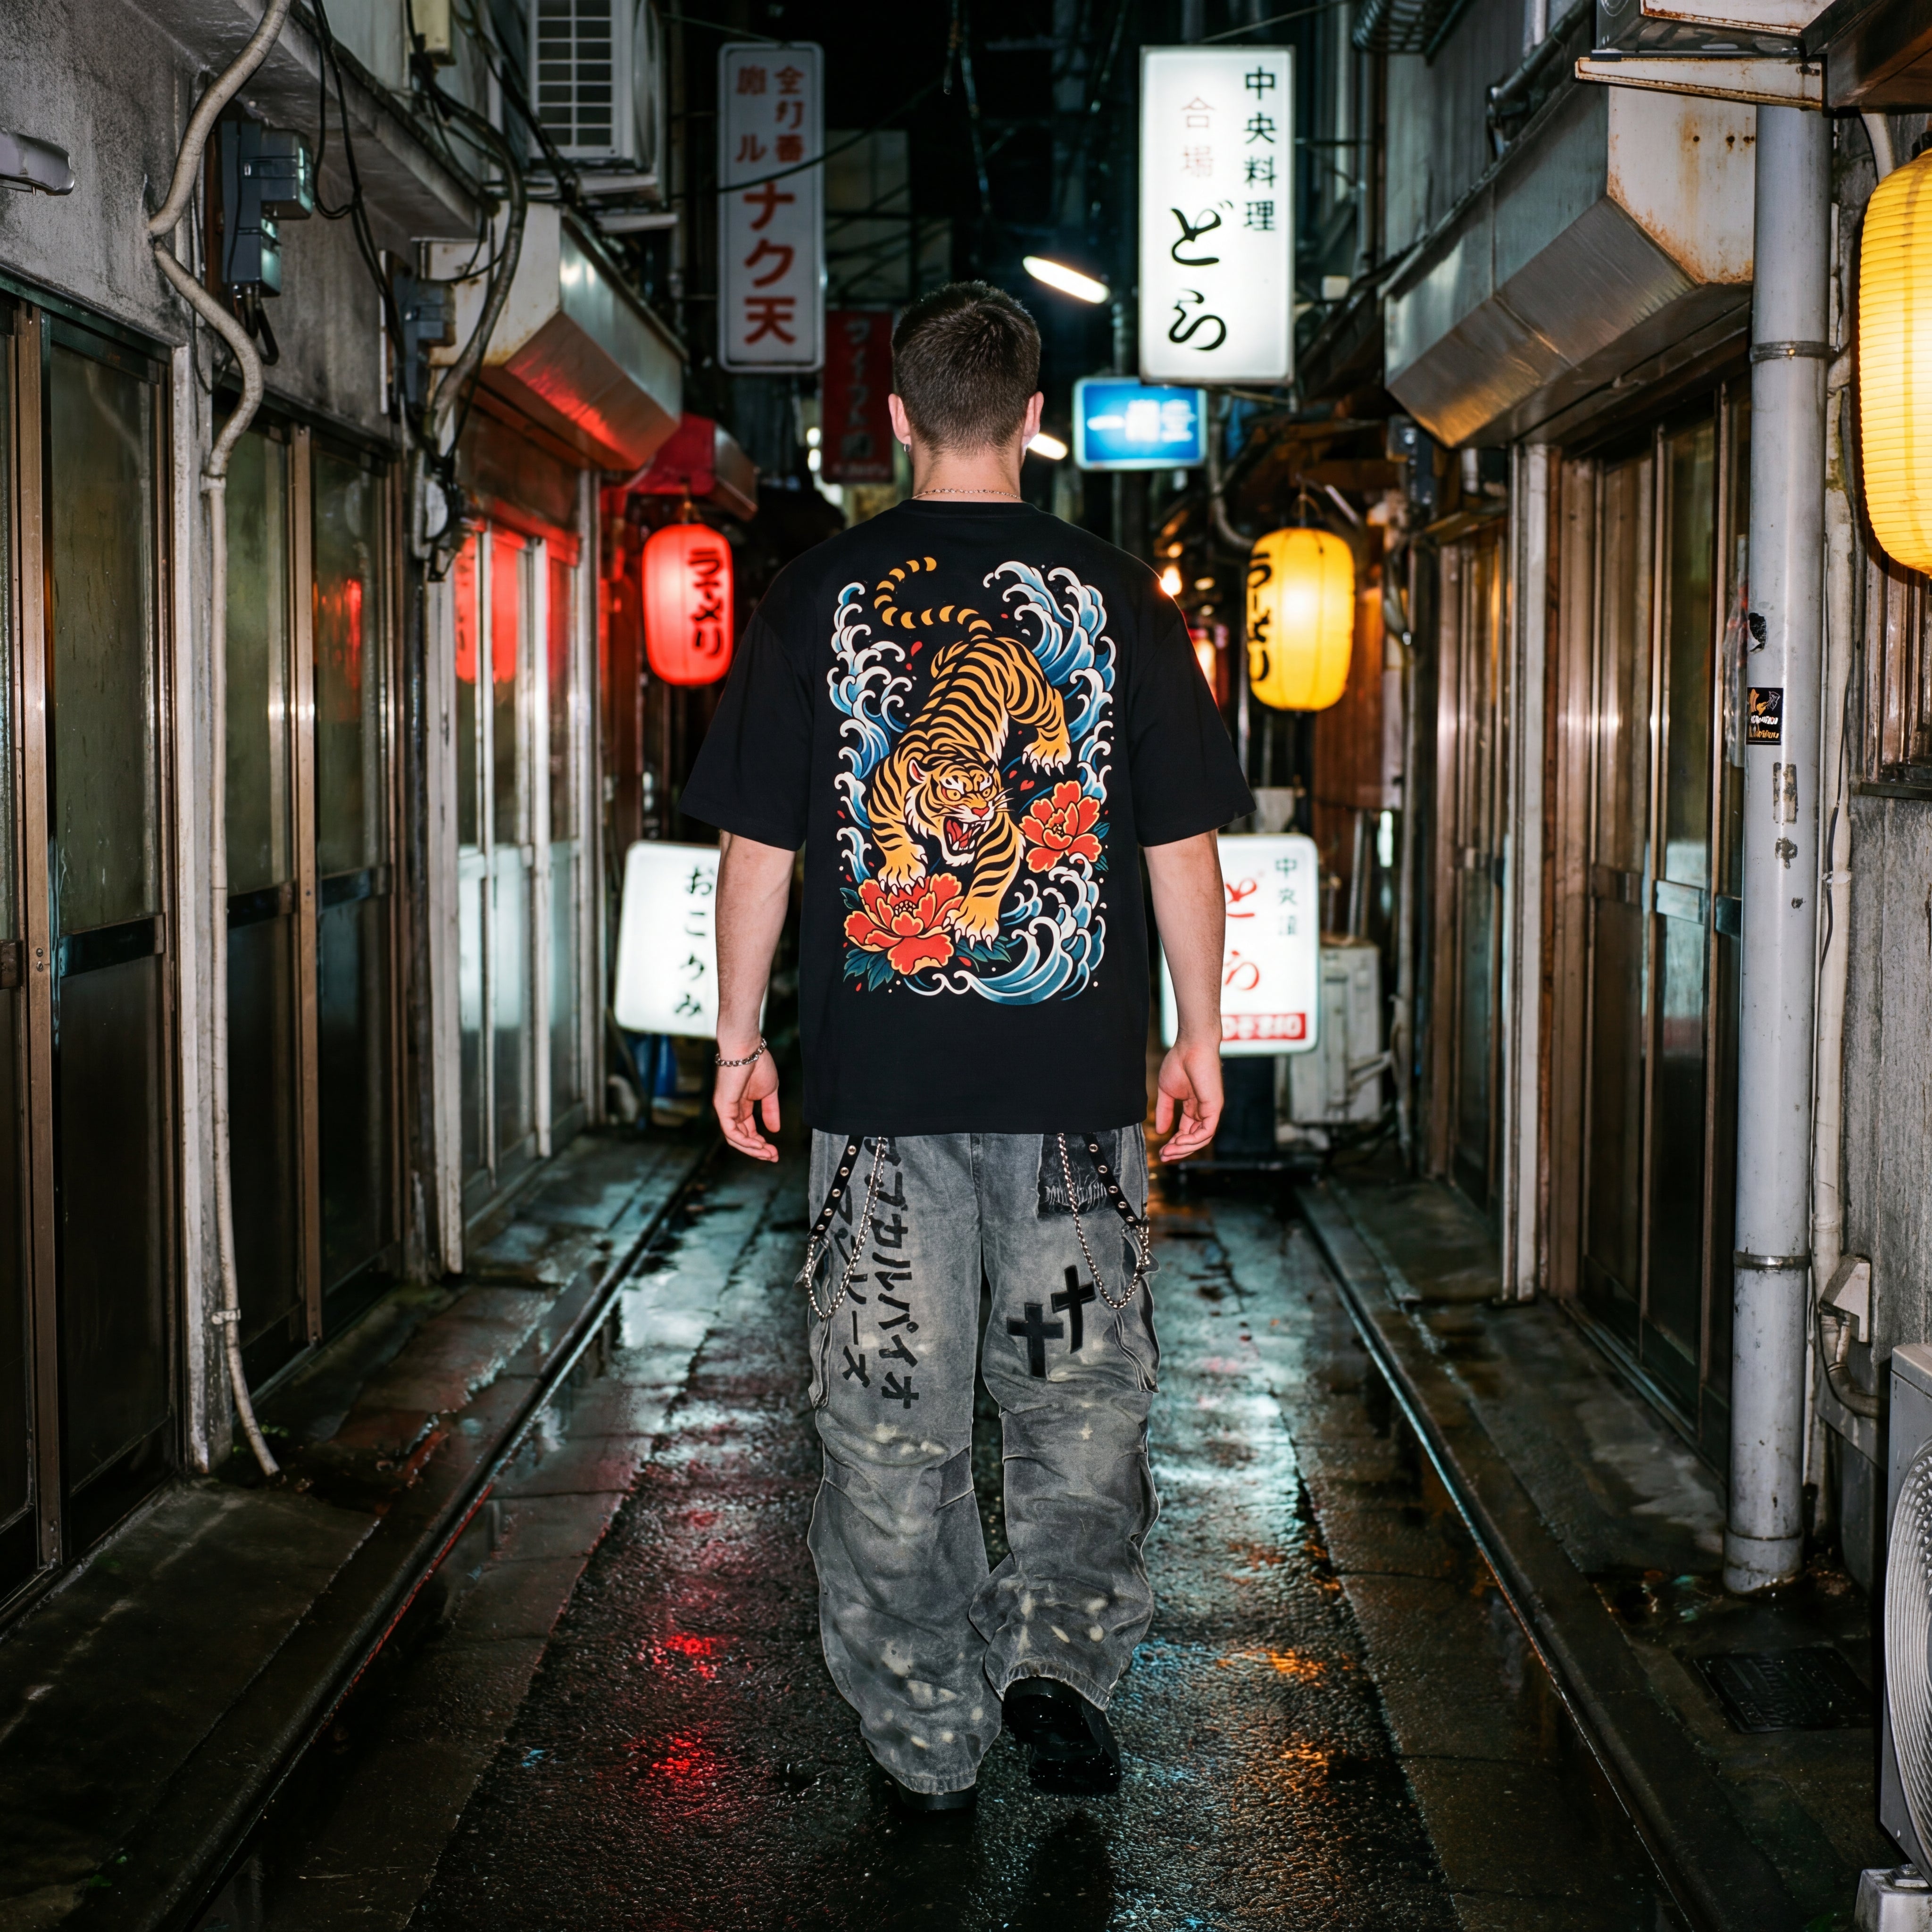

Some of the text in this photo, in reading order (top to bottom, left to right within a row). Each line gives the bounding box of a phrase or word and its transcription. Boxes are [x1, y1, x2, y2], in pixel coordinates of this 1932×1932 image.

[1243, 66, 1277, 231] 中央料理
[1168, 199, 1234, 351] どら
